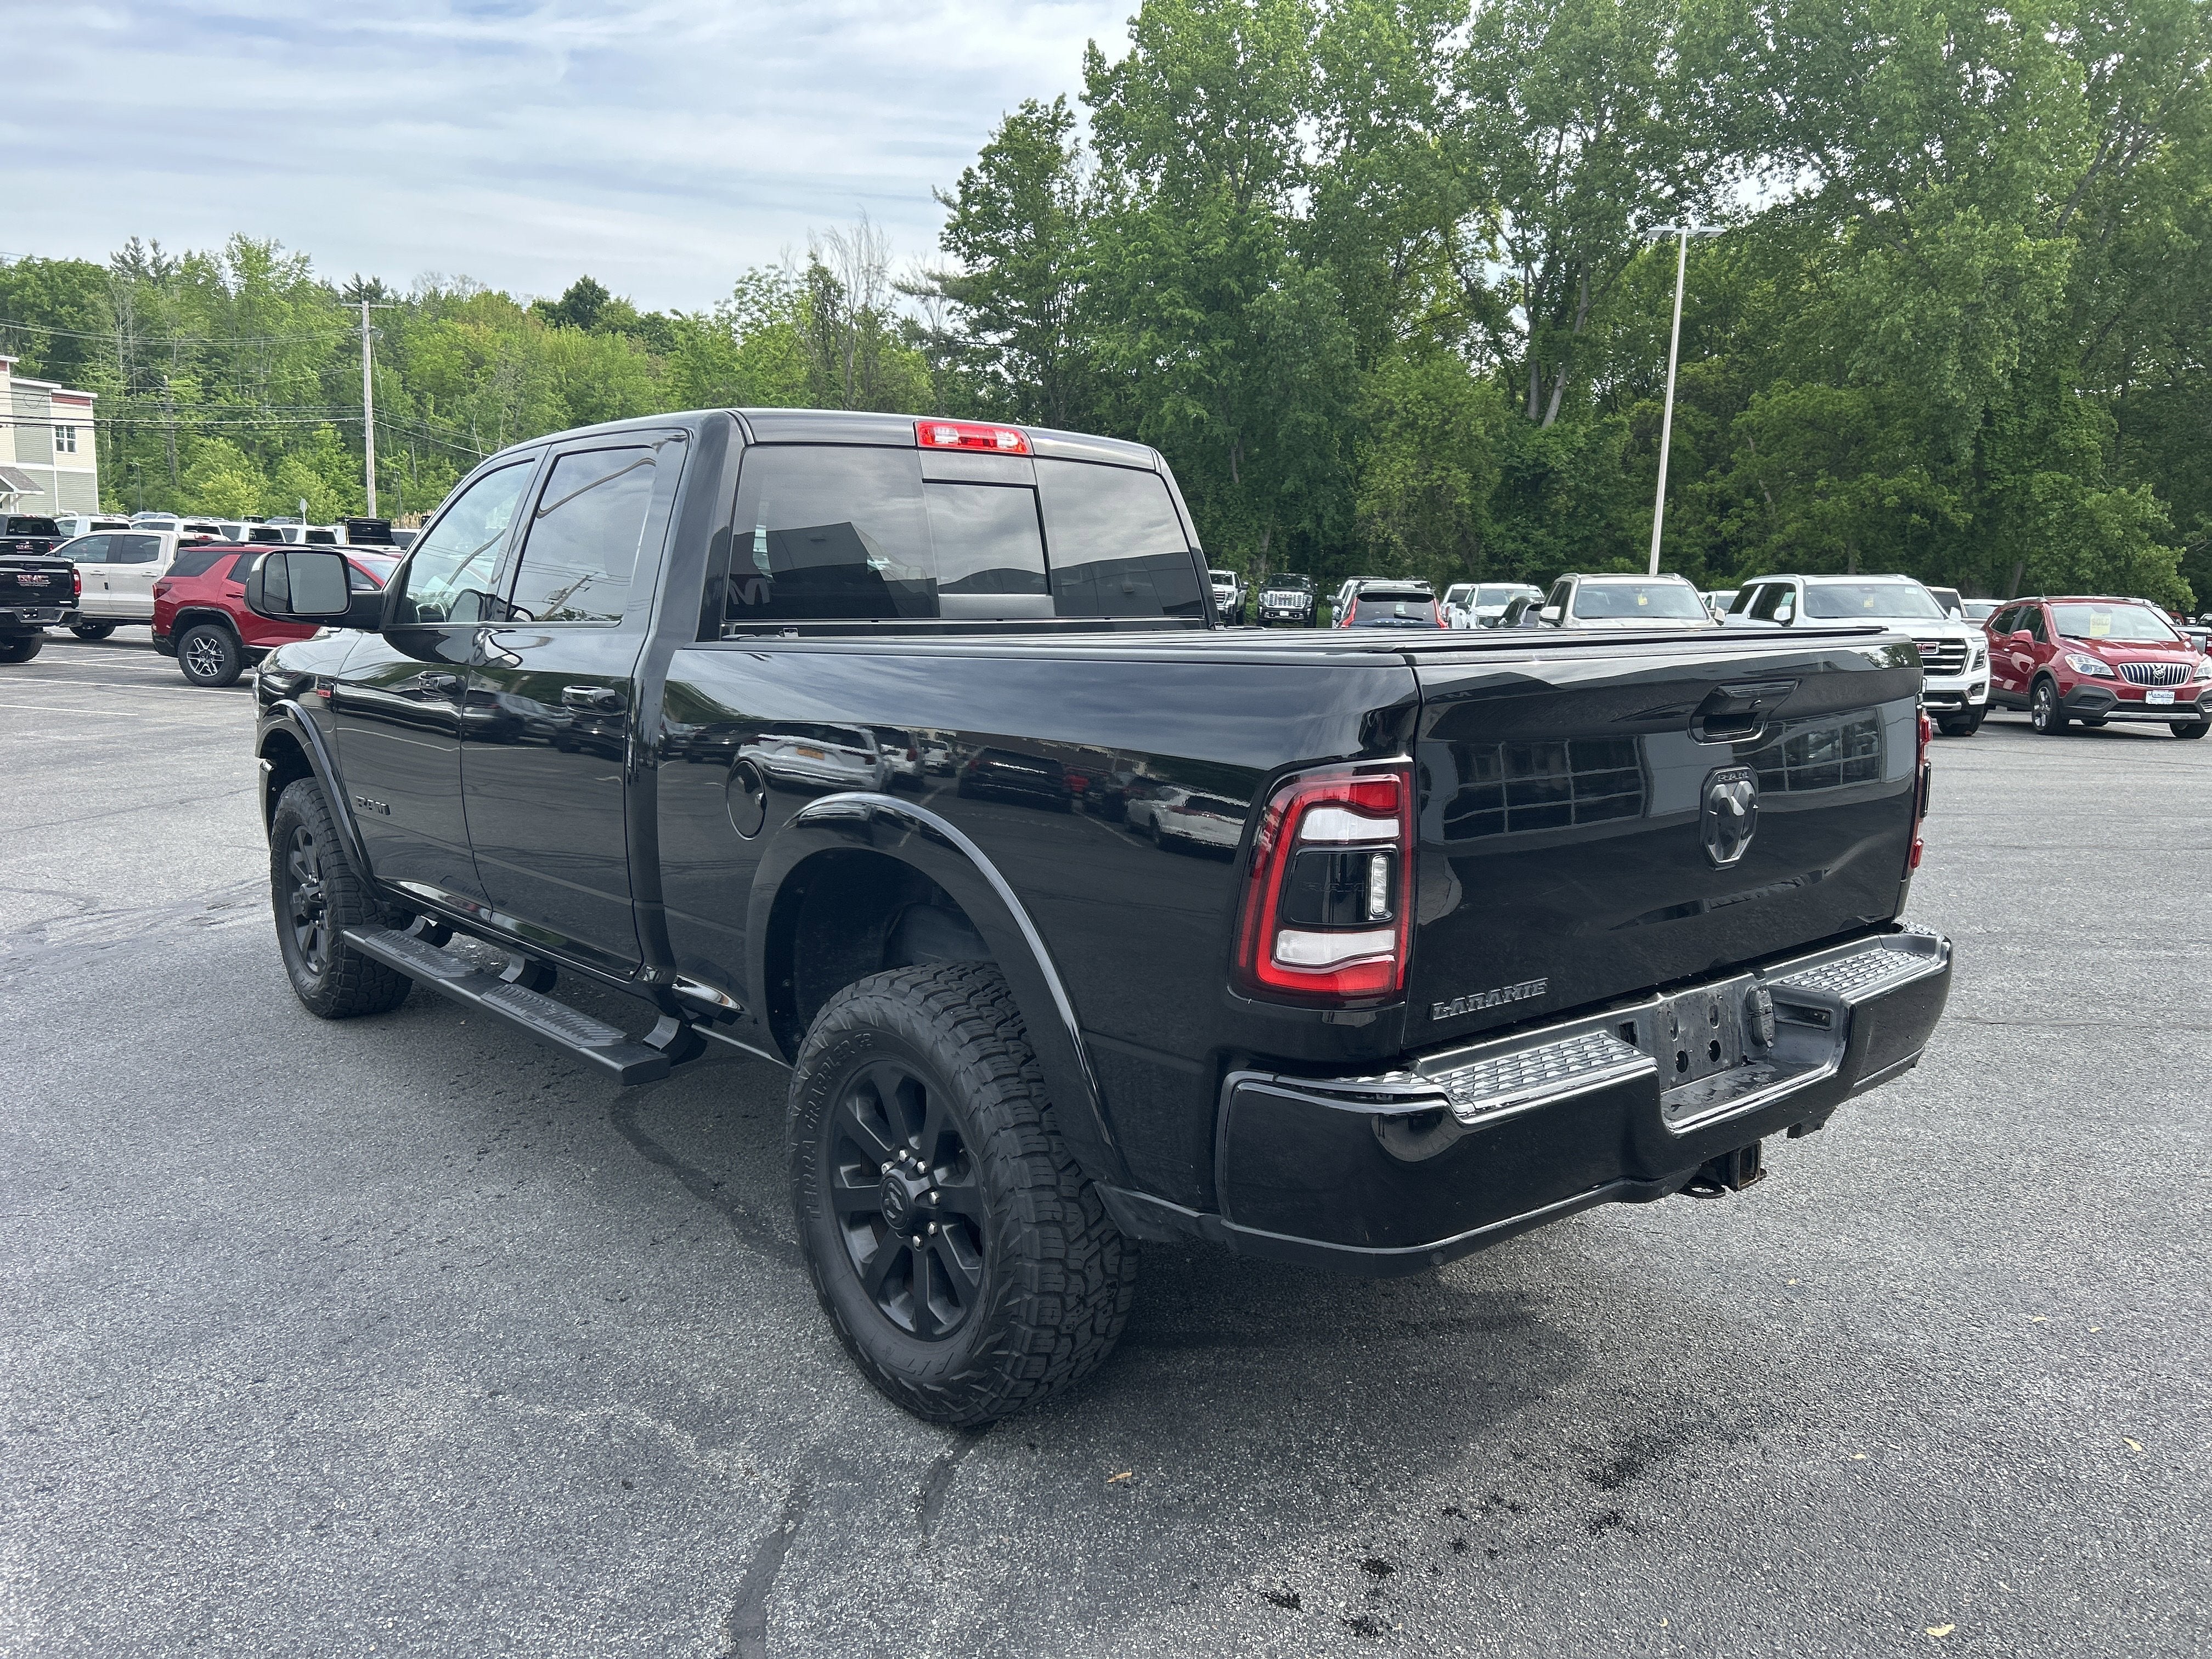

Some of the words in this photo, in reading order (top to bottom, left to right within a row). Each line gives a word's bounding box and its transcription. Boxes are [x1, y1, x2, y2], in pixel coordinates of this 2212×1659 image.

[17, 574, 49, 583] GMC
[1718, 771, 1749, 782] RAM
[355, 795, 391, 816] RAM
[1429, 978, 1549, 1020] LARAMIE
[803, 1139, 821, 1223] TERRA
